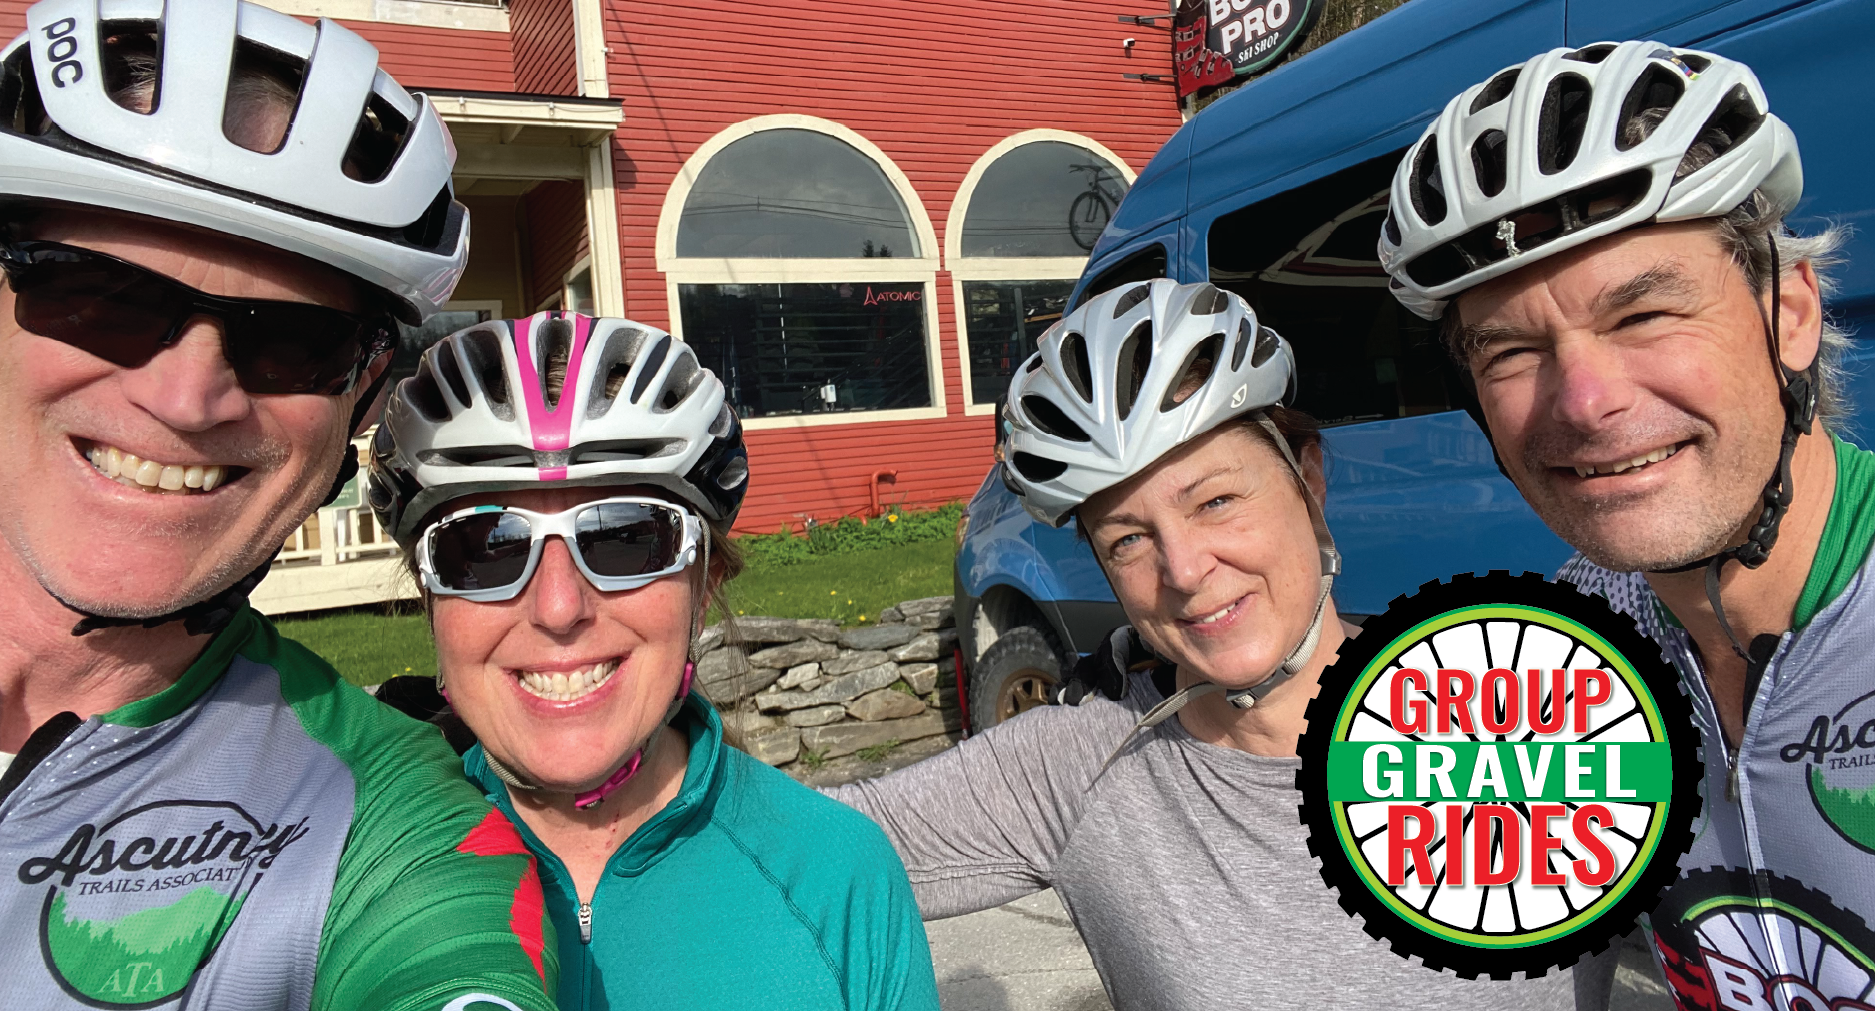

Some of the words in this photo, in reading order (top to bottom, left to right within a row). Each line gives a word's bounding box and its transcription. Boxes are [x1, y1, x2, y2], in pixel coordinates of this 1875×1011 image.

[1221, 0, 1290, 54] PRO
[1238, 47, 1253, 63] SKI
[1254, 32, 1279, 55] SHOP
[877, 291, 921, 301] ATOMIC
[1829, 754, 1875, 770] TRAIL
[79, 879, 145, 896] TRAILS
[100, 962, 165, 998] ATA
